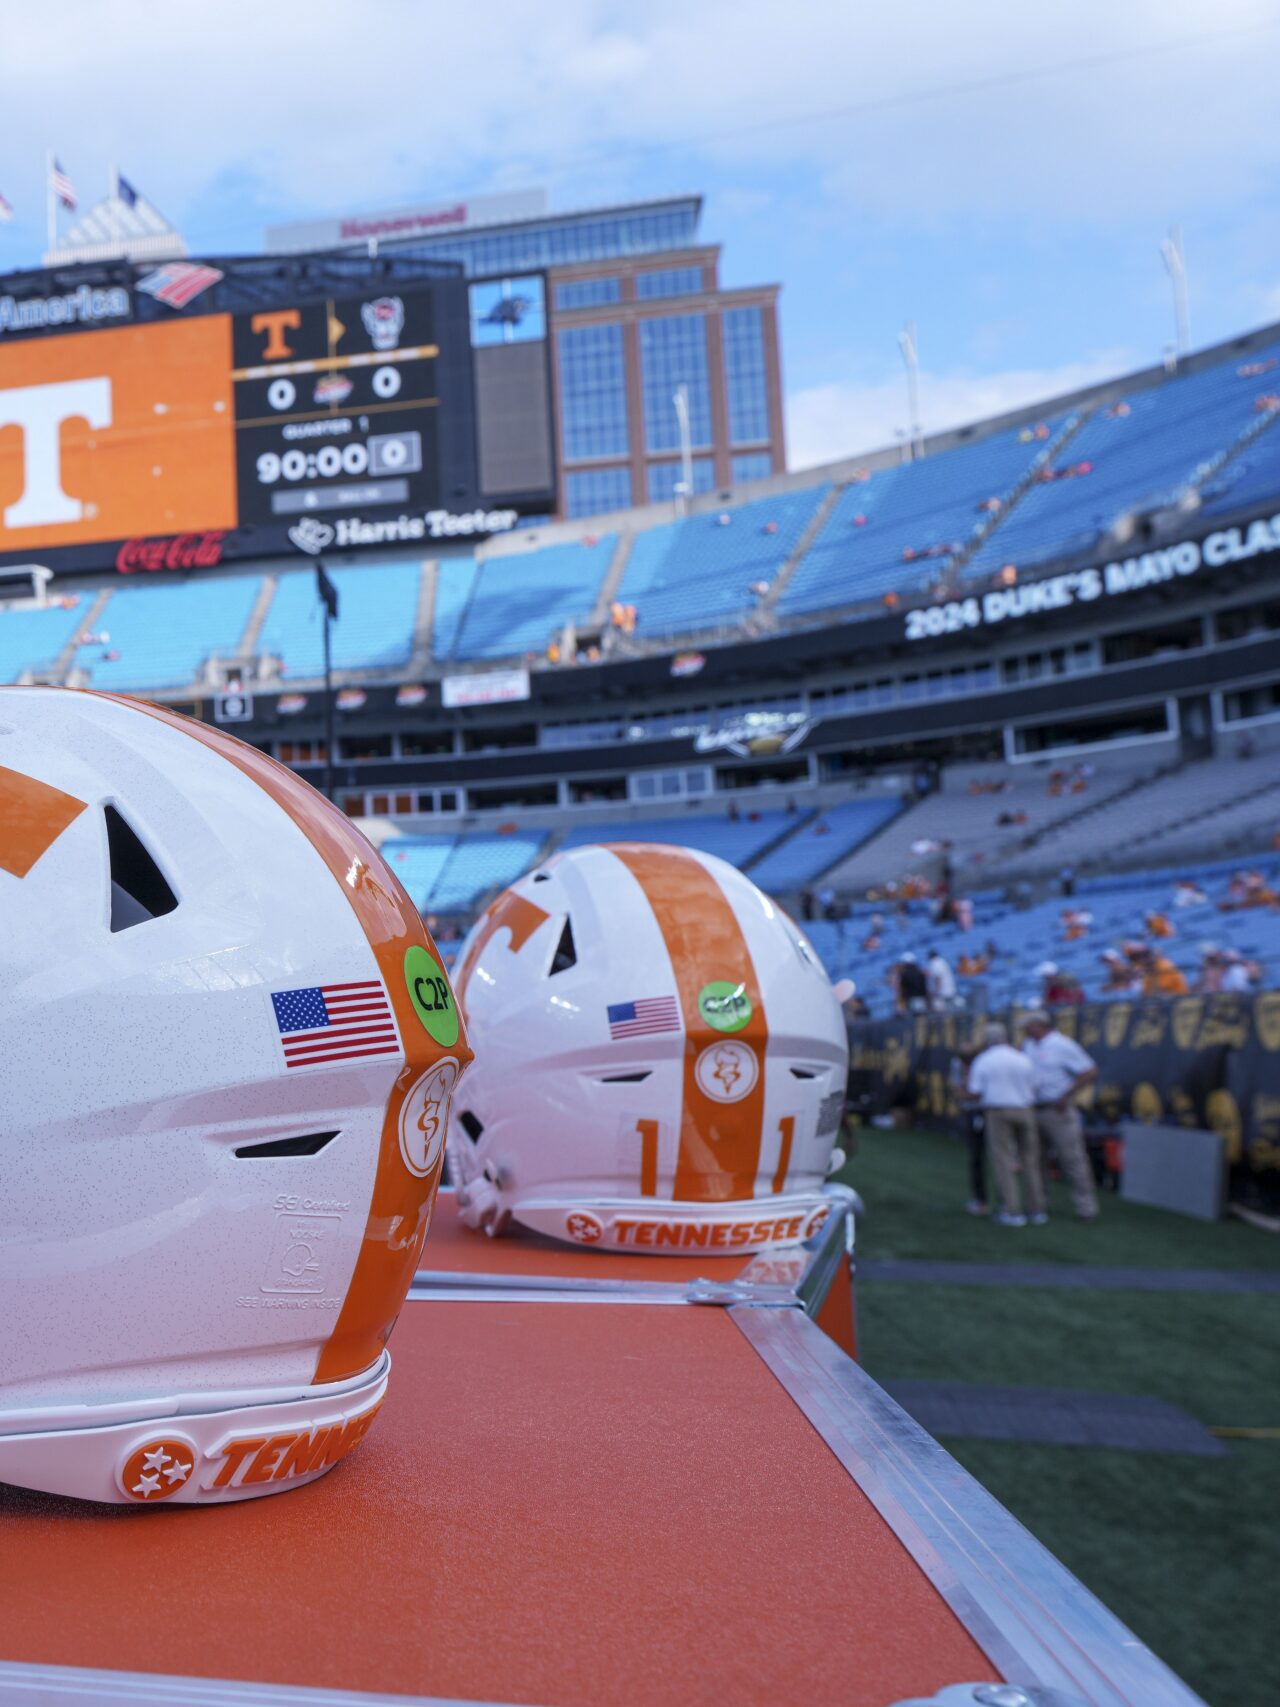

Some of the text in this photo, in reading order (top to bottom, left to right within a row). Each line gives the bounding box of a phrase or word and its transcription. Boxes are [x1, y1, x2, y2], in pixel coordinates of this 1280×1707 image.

[267, 378, 297, 411] 0
[372, 366, 402, 398] 0
[256, 442, 369, 484] 90:00
[381, 439, 407, 468] 0
[335, 508, 518, 546] Harris Teeter
[905, 598, 980, 640] 2024
[982, 568, 1102, 624] DUKE'S
[1104, 541, 1200, 594] MAYO
[414, 977, 448, 1011] C2P
[614, 1216, 805, 1246] TENNESSEE
